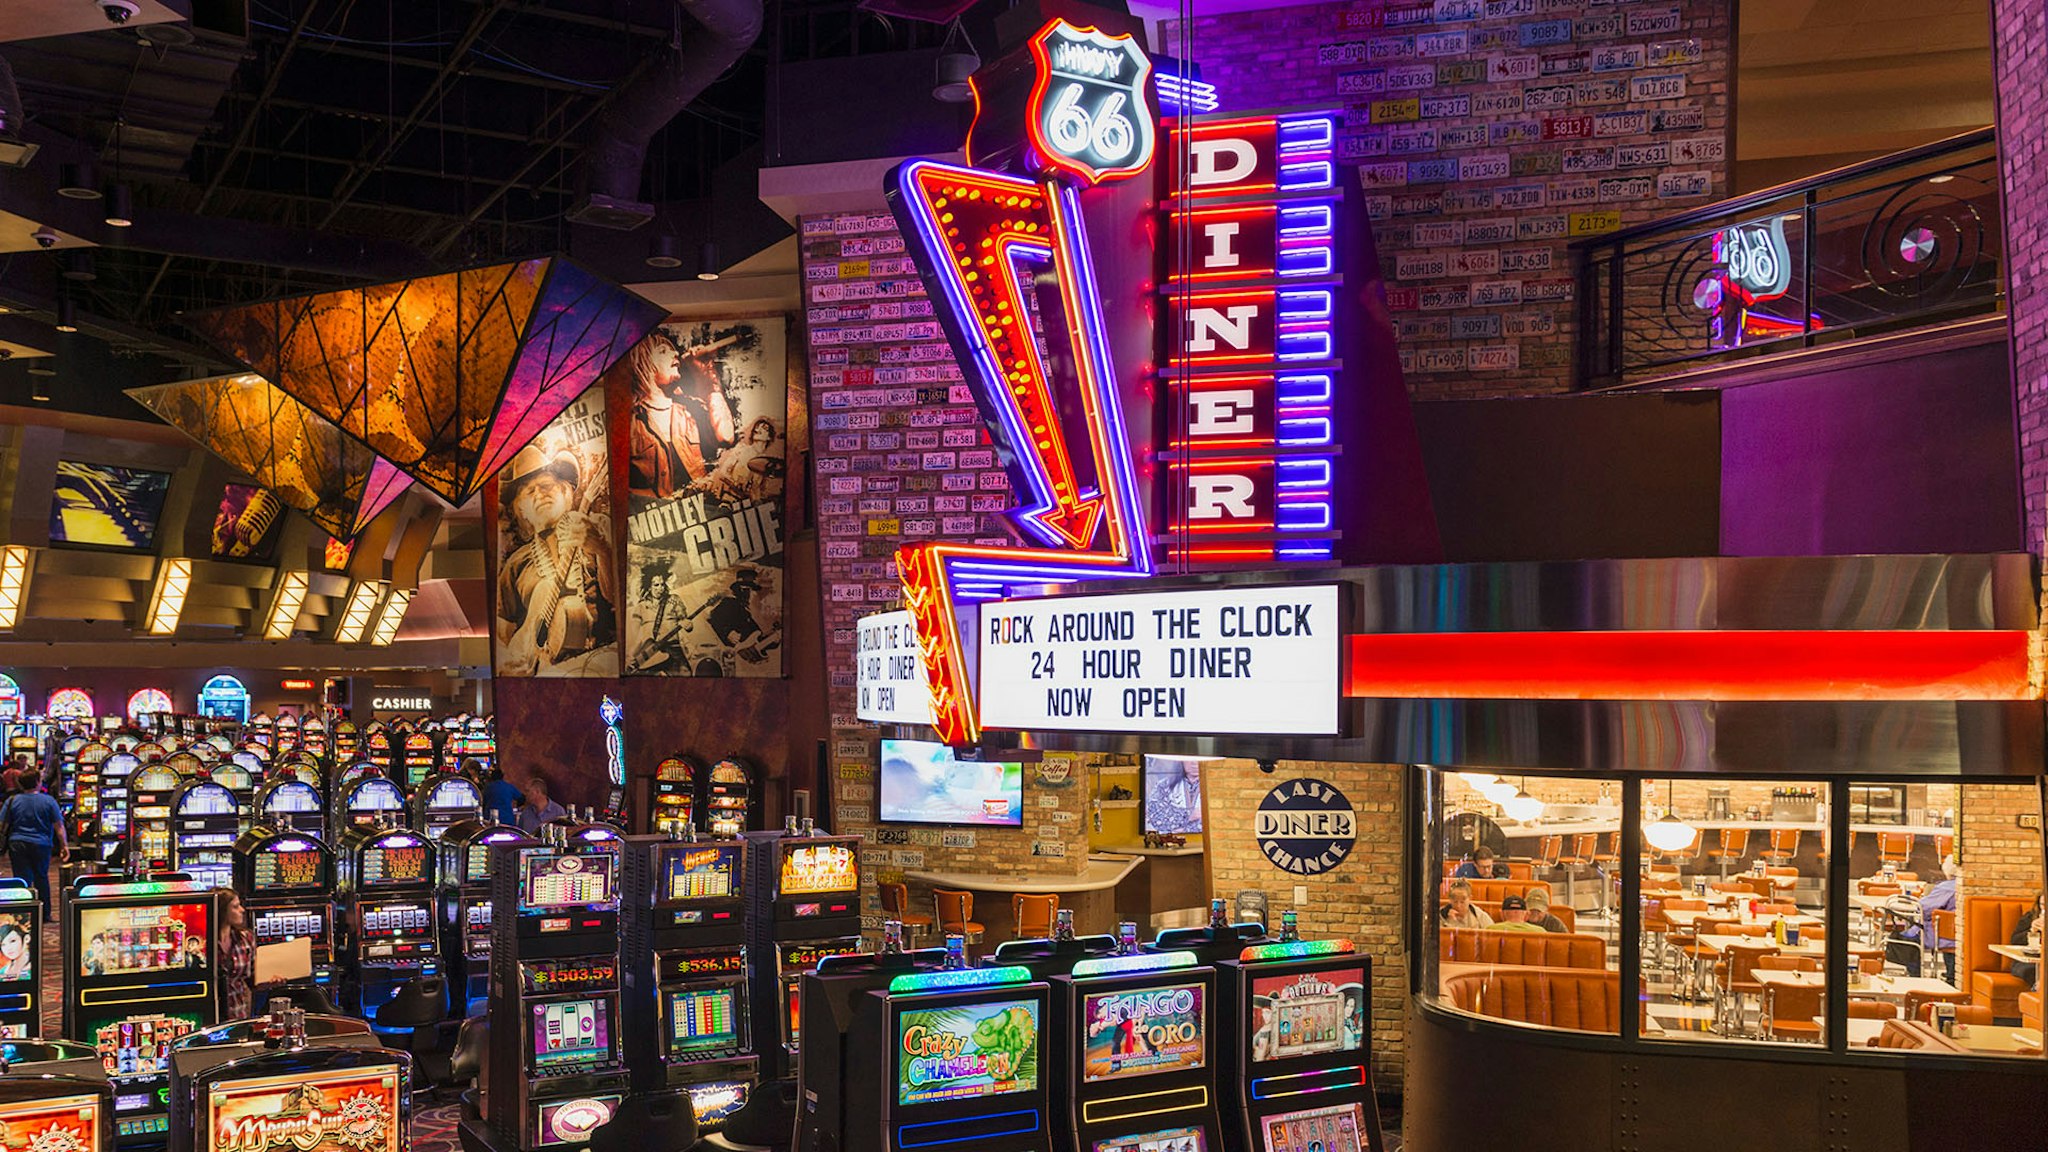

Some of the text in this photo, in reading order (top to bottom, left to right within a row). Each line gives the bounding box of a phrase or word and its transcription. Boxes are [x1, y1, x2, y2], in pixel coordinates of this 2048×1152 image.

[1531, 26, 1558, 39] 9089
[1049, 82, 1135, 160] 66
[1379, 104, 1404, 119] 2154
[1553, 121, 1580, 135] 5813
[1695, 142, 1723, 157] 8785
[1420, 165, 1446, 178] 9092
[1578, 217, 1606, 231] 2173
[1186, 138, 1258, 519] DINER
[1462, 320, 1488, 333] 9097
[1530, 319, 1550, 332] 905
[628, 493, 708, 544] MÖTLEY
[684, 499, 784, 575] CRÜE
[991, 604, 1313, 645] ROCK AROUND THE CLOCK
[889, 655, 915, 681] DINER
[1031, 646, 1252, 680] 24 HOUR DINER
[373, 697, 433, 710] CASHIER
[878, 687, 895, 711] OPEN
[1047, 687, 1185, 718] NOW OPEN
[1042, 764, 1067, 774] Coffee
[1272, 781, 1336, 804] LAST
[1258, 813, 1350, 835] DINER
[1263, 840, 1347, 873] CHANCE
[534, 967, 614, 985] $1503.59
[678, 957, 741, 974] $536.15
[1098, 989, 1195, 1024] TANGO
[903, 1025, 969, 1060] Crazy
[1148, 1022, 1196, 1047] ORO
[909, 1053, 1011, 1085] CHAMELEON
